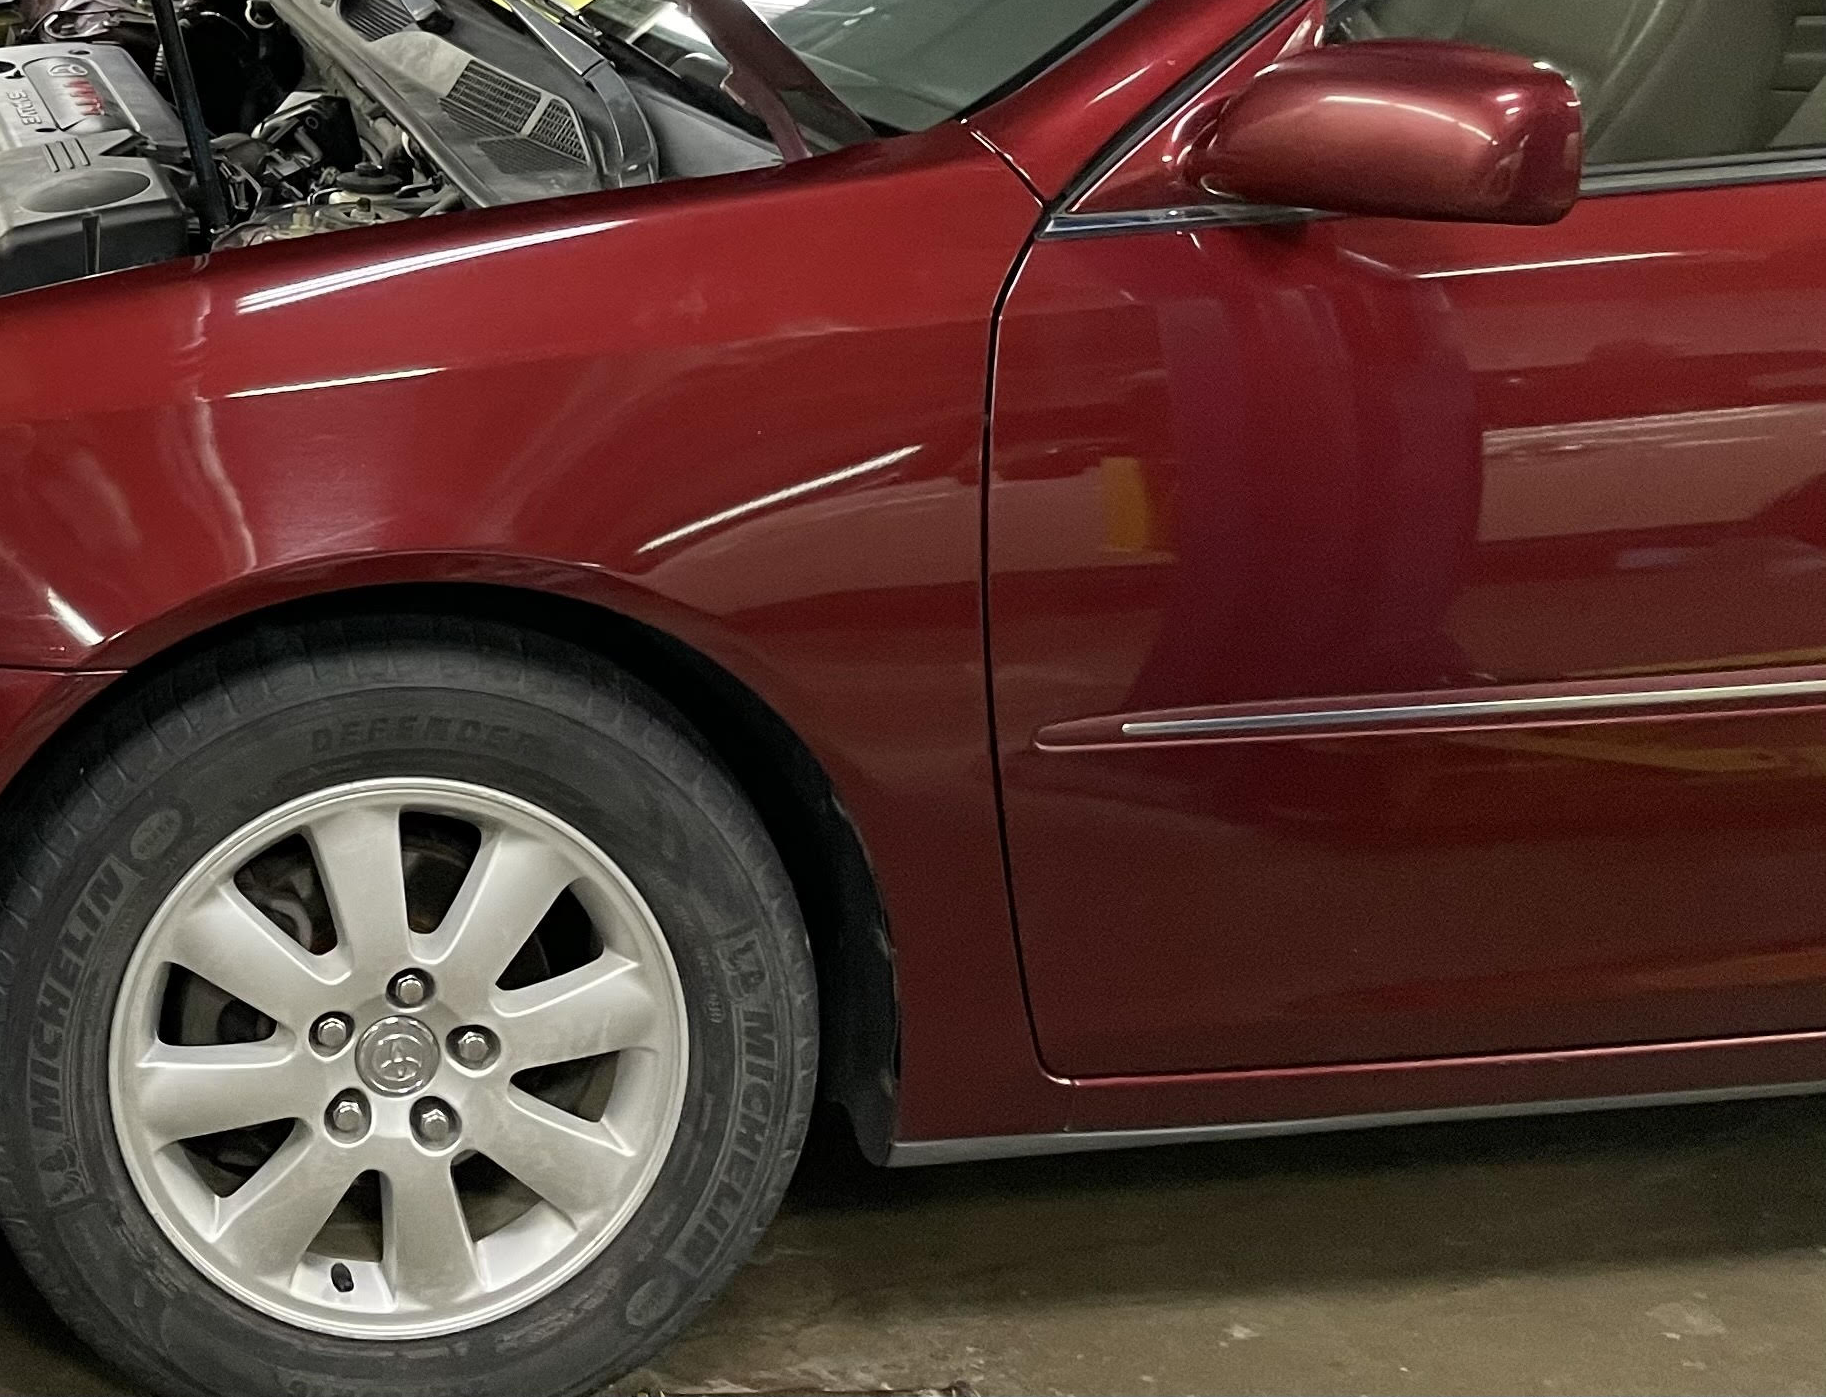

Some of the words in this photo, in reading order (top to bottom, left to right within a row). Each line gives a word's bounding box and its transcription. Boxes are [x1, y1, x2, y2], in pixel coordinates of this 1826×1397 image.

[312, 715, 547, 753] DEFENDER
[30, 861, 124, 1132] MICHELIN
[682, 1009, 775, 1273] MICHELIN
